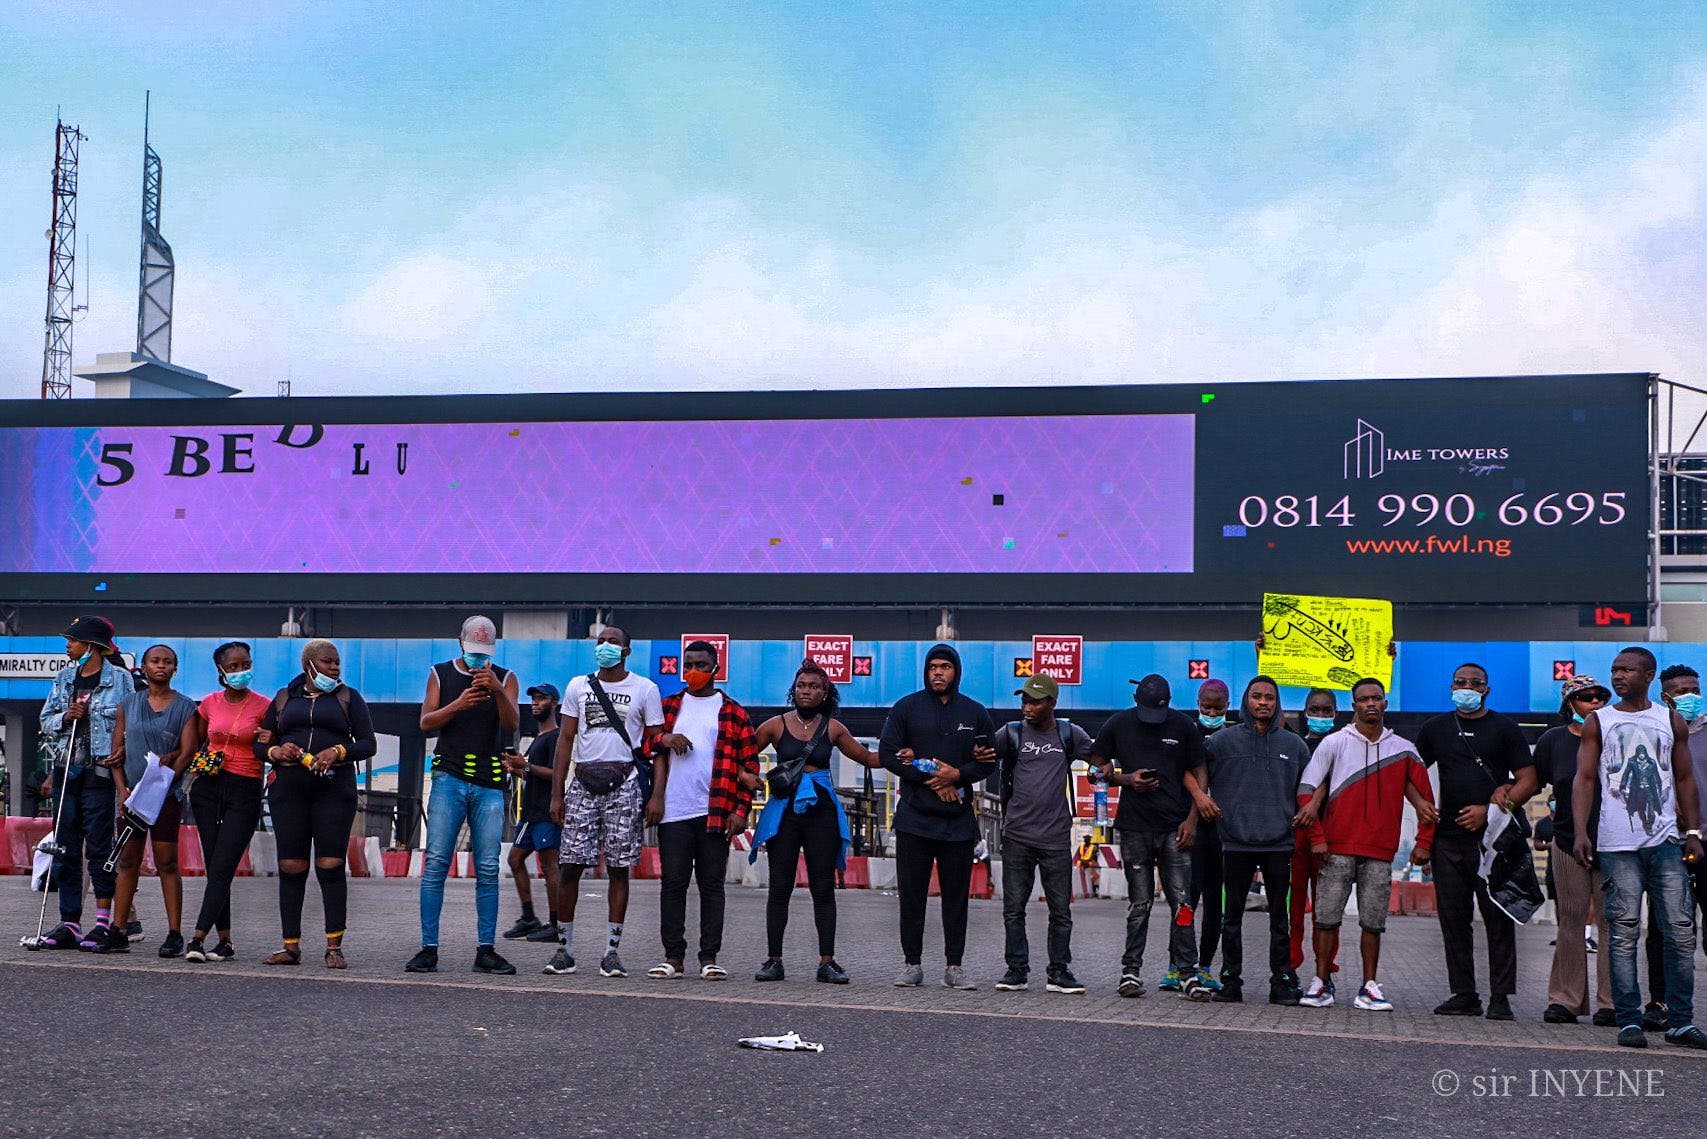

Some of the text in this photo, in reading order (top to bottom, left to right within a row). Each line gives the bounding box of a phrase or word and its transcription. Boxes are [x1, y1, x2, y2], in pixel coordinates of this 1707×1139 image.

[1428, 448, 1509, 460] TOWERS
[96, 443, 135, 487] 5
[1239, 492, 1627, 527] 0814 990 6695
[1346, 534, 1512, 557] www.fwl.ng
[807, 641, 849, 651] EXACT
[1036, 641, 1078, 652] EXACT
[813, 654, 844, 664] FARE
[1041, 654, 1073, 665] FARE
[0, 659, 46, 672] MIRALTY
